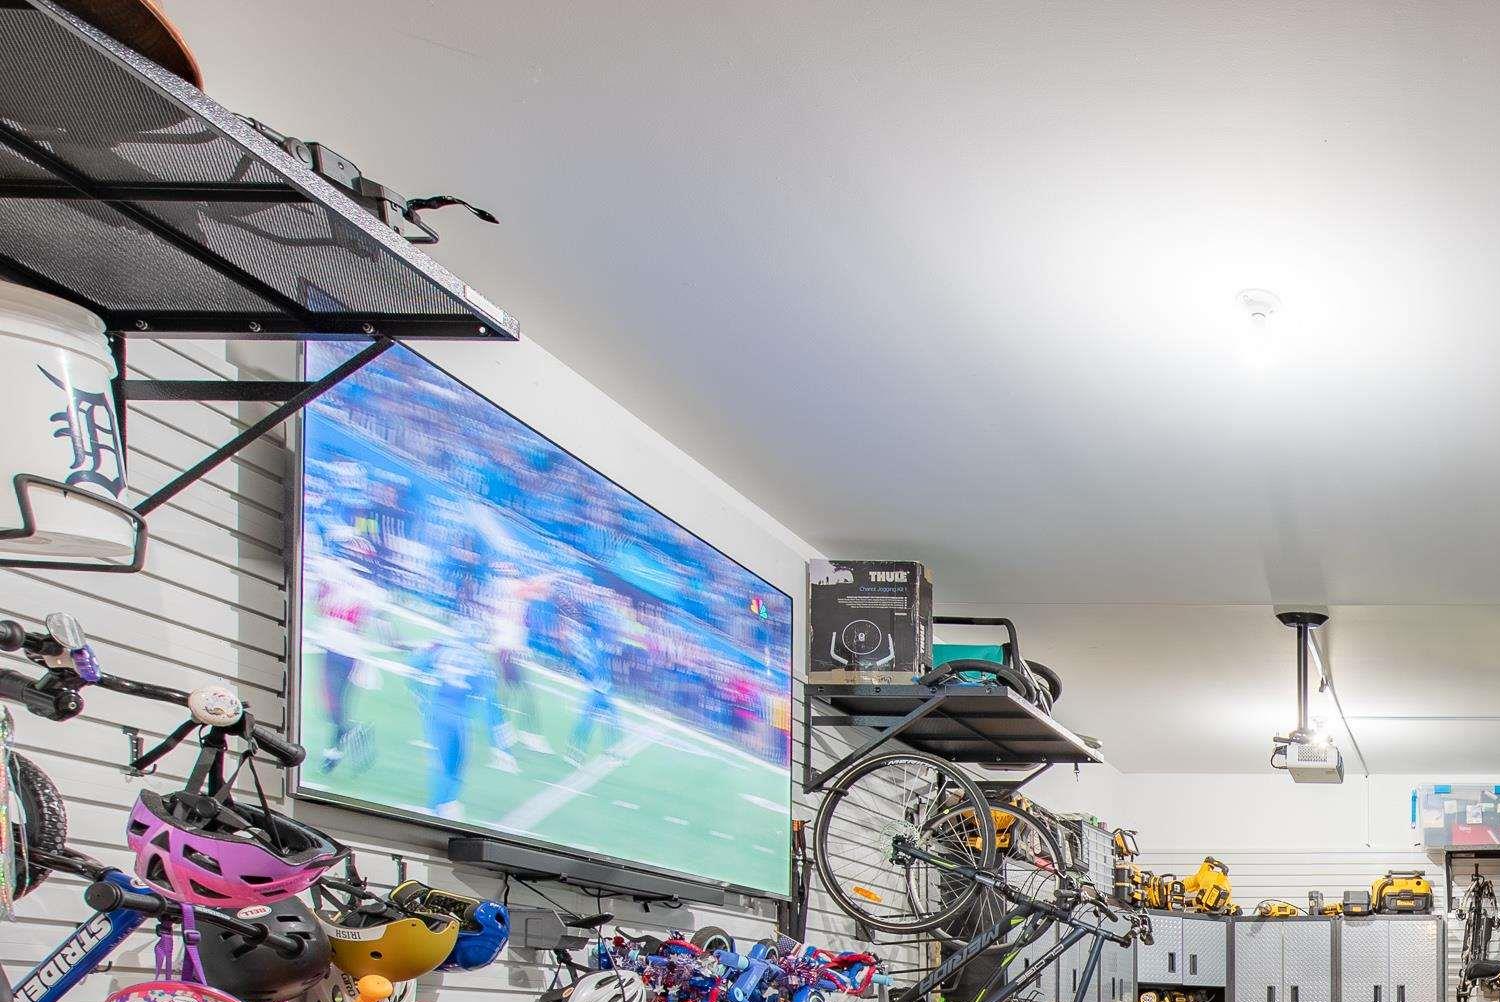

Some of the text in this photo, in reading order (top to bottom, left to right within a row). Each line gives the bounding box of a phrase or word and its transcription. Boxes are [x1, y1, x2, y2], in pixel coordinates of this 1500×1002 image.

[868, 570, 908, 582] THULE
[241, 907, 268, 917] BELL
[335, 929, 362, 940] IRISH
[340, 972, 357, 998] GIRO
